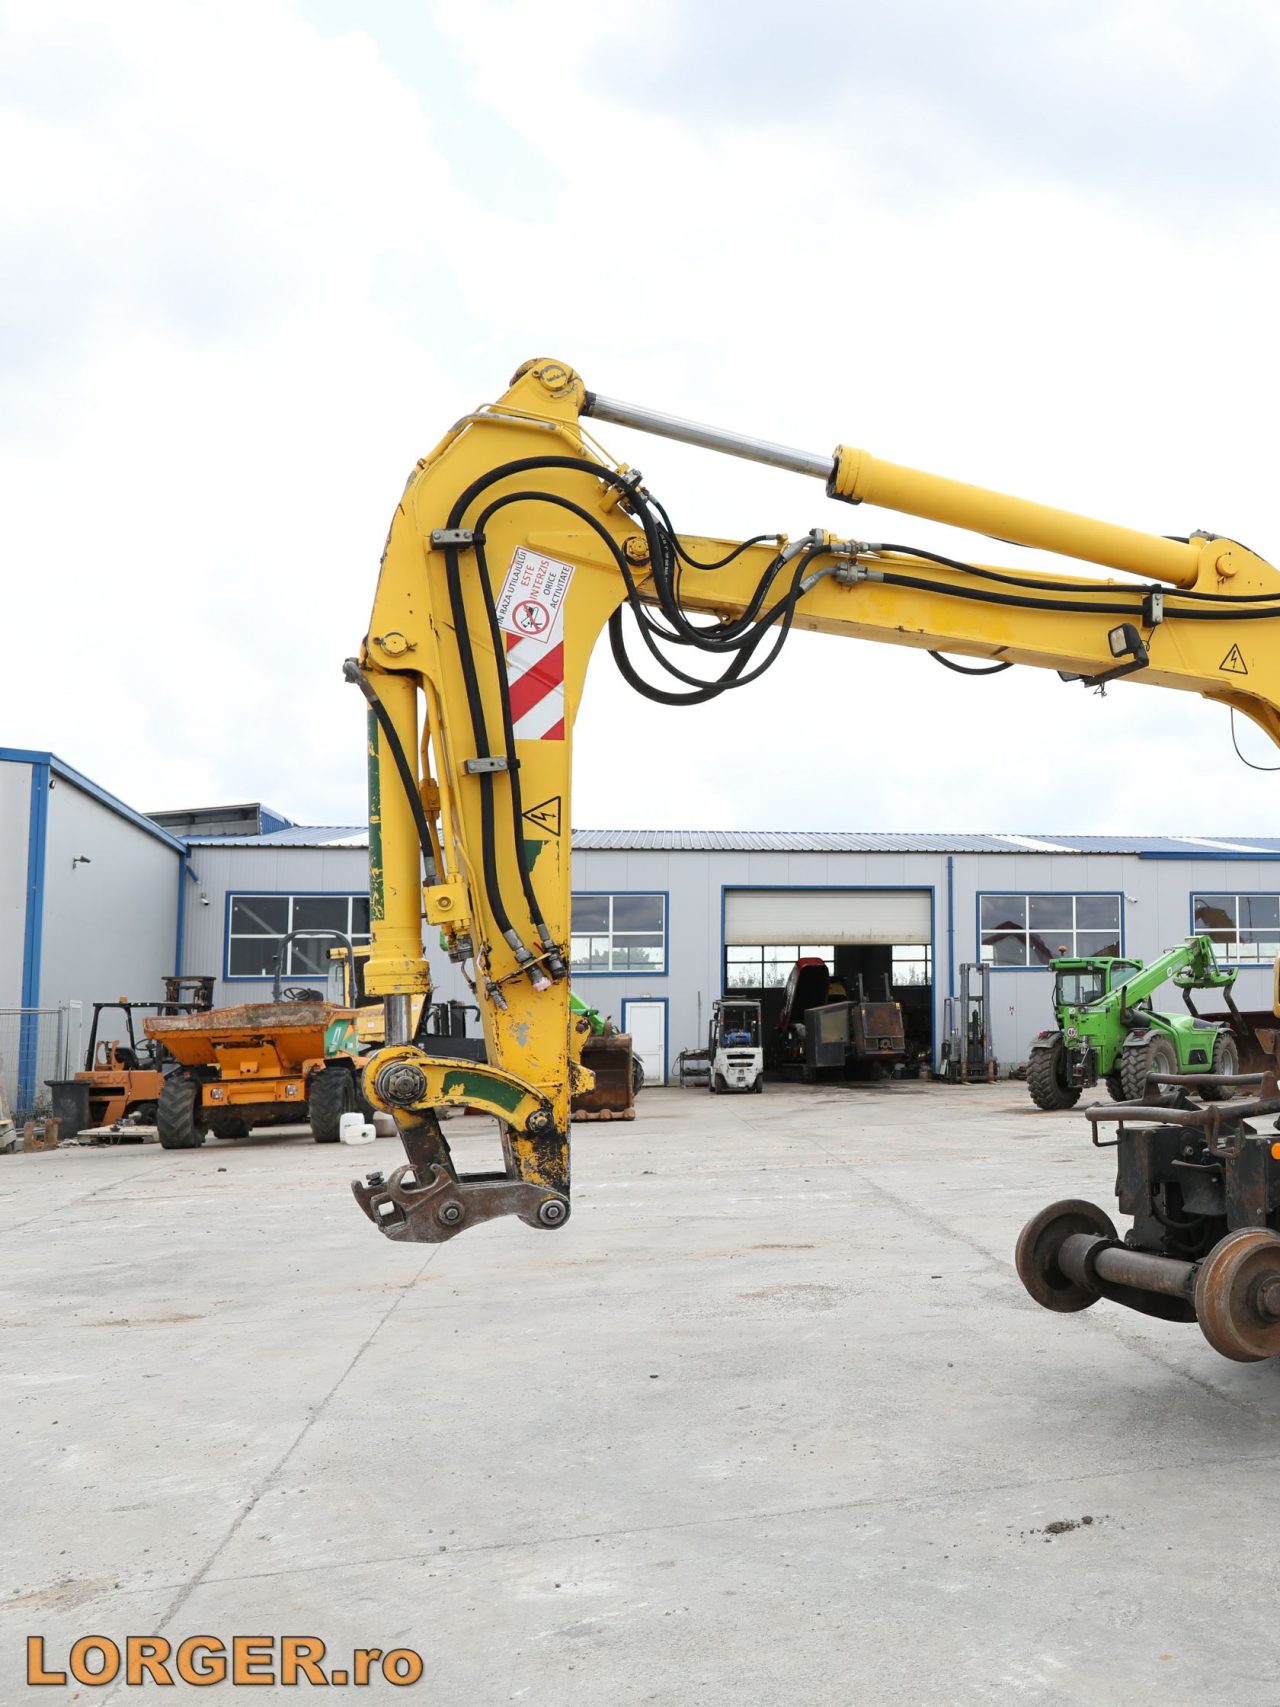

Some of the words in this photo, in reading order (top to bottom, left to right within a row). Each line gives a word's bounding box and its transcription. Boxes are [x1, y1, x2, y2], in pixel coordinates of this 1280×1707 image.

[500, 595, 513, 615] RAZA
[508, 551, 528, 594] UTILAJULUI
[521, 565, 535, 587] ESTE
[529, 560, 550, 600] INTERZIS
[543, 572, 557, 596] ORICE
[550, 566, 570, 609] ACTIVITATE
